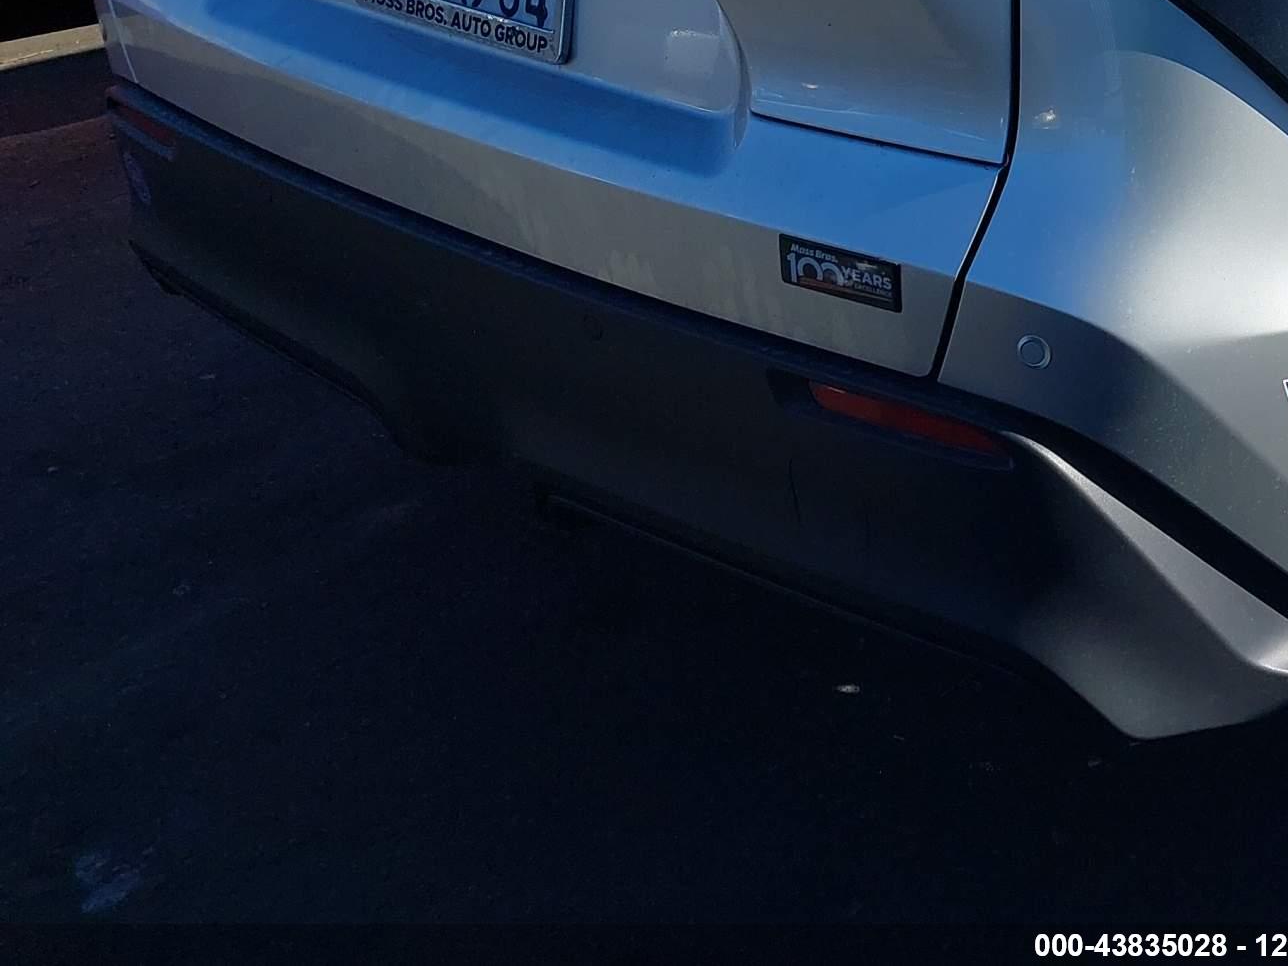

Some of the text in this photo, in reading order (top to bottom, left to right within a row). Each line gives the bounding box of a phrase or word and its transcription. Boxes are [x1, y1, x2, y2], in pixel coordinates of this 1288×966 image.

[450, 14, 492, 39] AUTO
[494, 24, 549, 55] GROUP
[841, 265, 893, 291] YEARS
